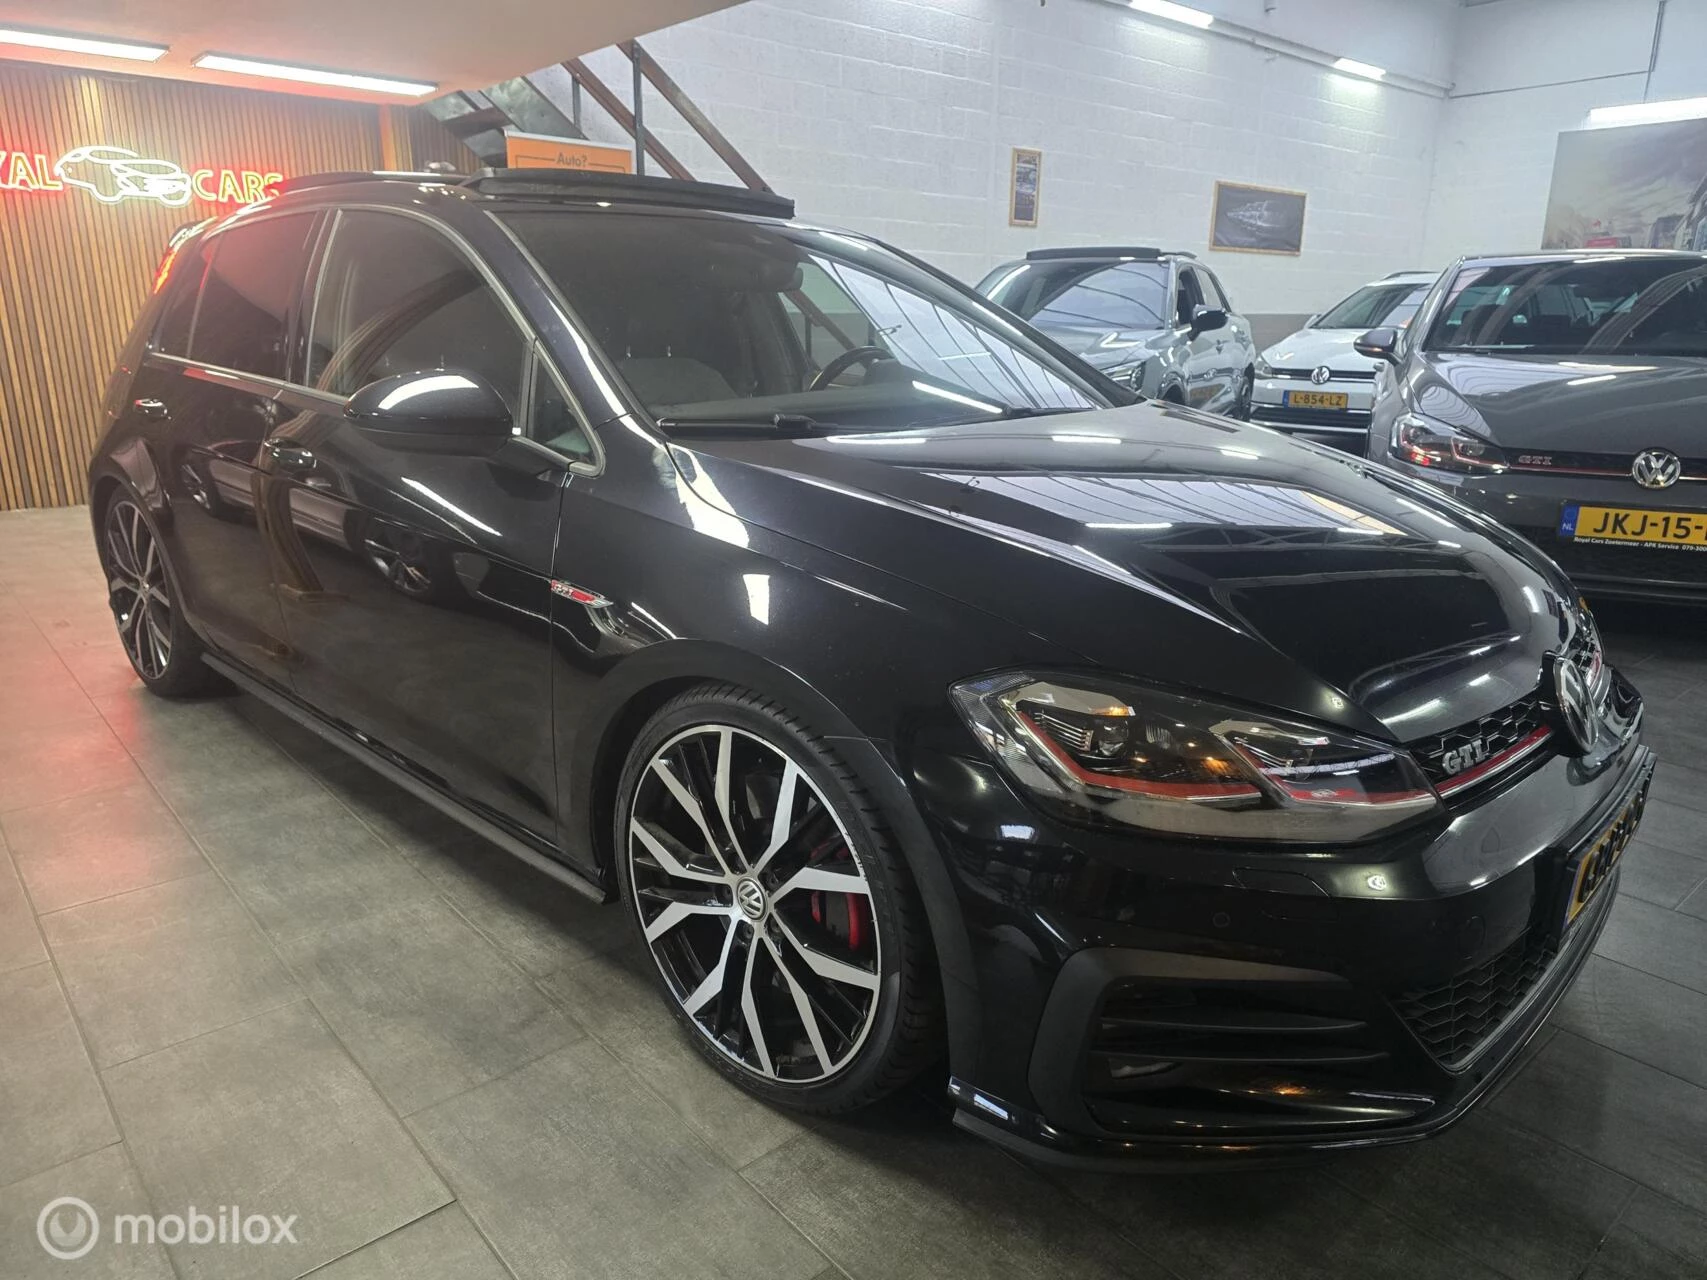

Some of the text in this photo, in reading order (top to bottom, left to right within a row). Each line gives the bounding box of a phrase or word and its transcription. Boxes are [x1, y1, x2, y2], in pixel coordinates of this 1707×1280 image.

[556, 152, 588, 168] Auto?
[1294, 394, 1343, 406] L-854-LZ
[1518, 455, 1552, 466] GTI
[1562, 522, 1574, 531] NL
[1593, 512, 1707, 541] JKJ-15-
[1574, 536, 1590, 544] Royal
[1605, 539, 1640, 547] Zoetermeer
[1658, 543, 1680, 551] Service
[1442, 739, 1486, 775] GTI
